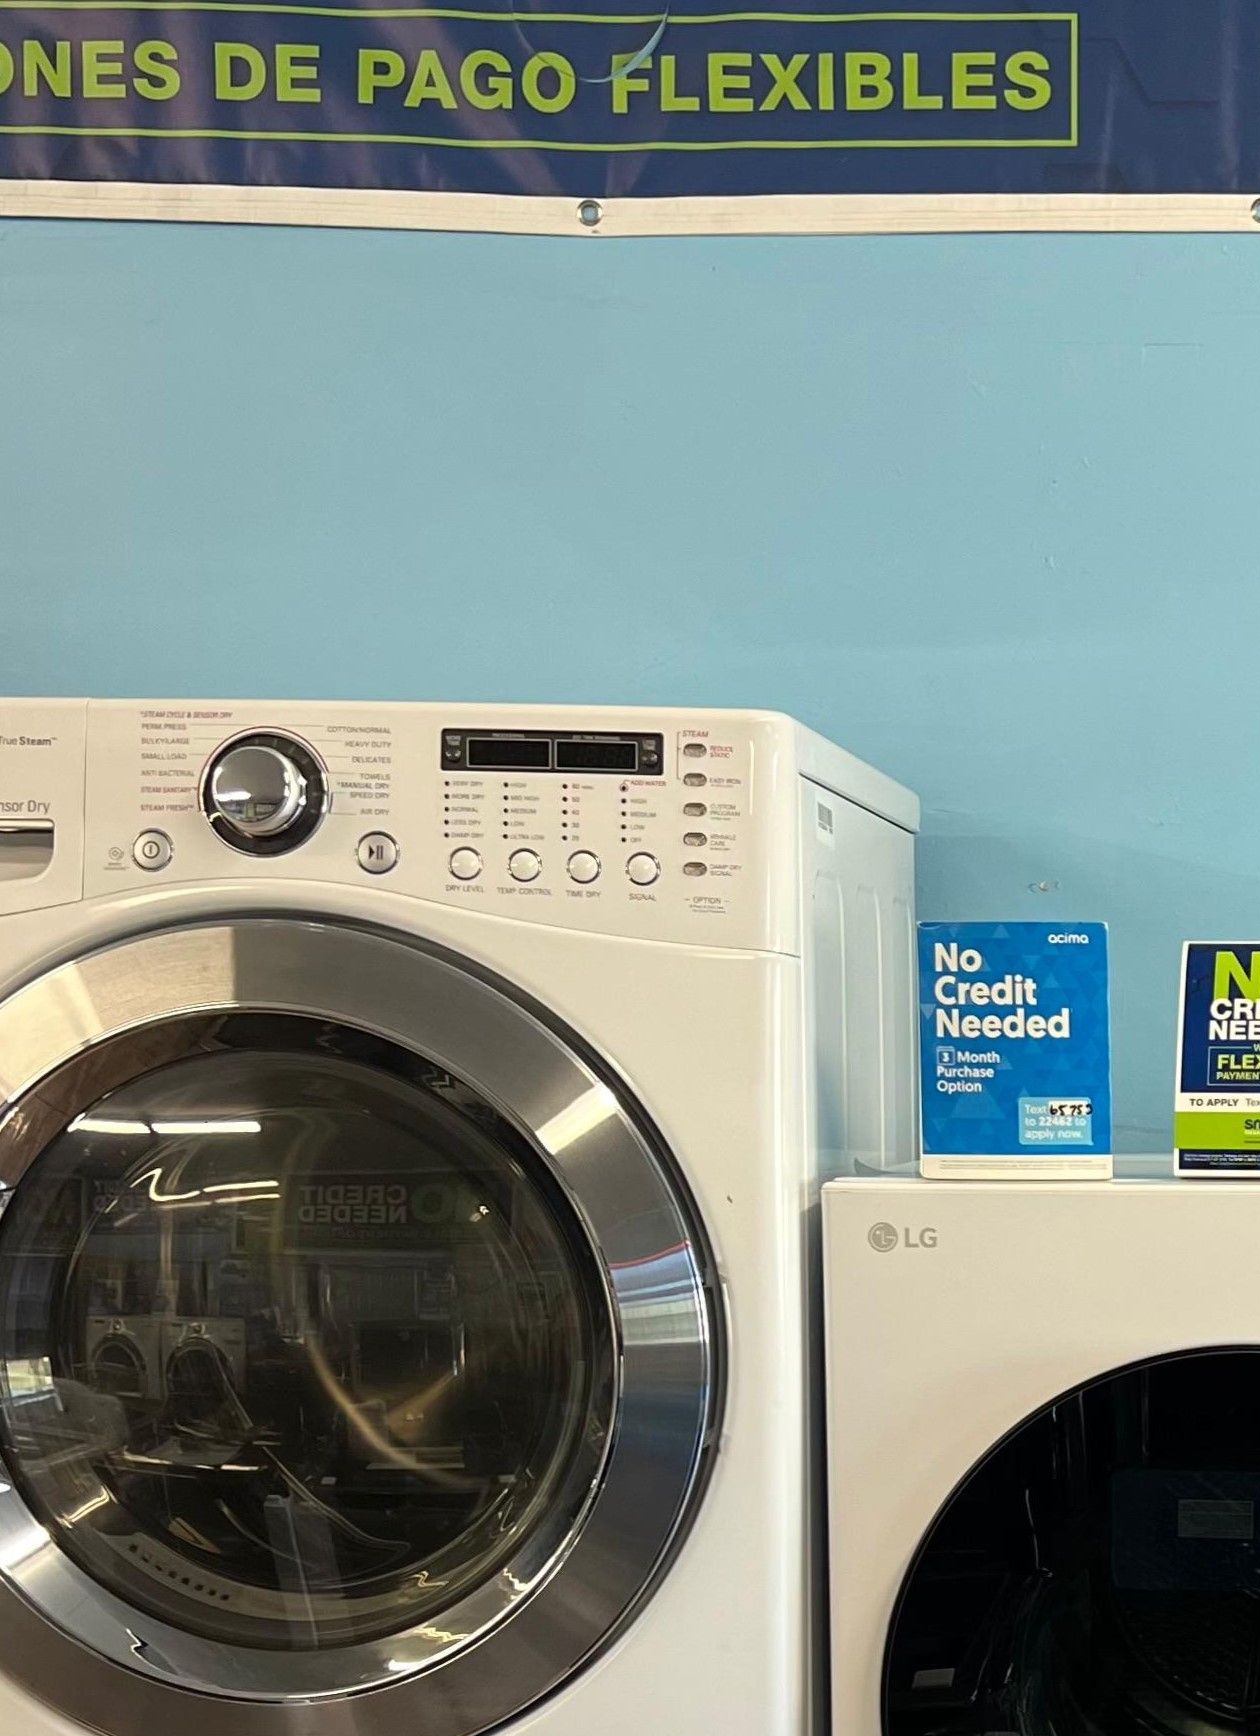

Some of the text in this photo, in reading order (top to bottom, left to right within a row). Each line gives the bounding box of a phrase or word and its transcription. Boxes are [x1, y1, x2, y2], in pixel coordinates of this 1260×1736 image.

[0, 40, 1052, 114] NES DE PAGO FLEXIBLES
[682, 730, 709, 738] STEAM
[27, 800, 51, 815] Dry
[446, 884, 461, 892] DRY
[693, 896, 721, 904] OPTION
[1048, 933, 1089, 945] acima
[934, 942, 982, 972] No
[934, 974, 1037, 1006] Credit
[936, 1008, 1071, 1038] Needed
[957, 1051, 1000, 1063] Month
[936, 1066, 994, 1078] Purchase
[936, 1080, 982, 1095] Option
[1190, 1098, 1205, 1106] TO
[1207, 1098, 1239, 1107] APPLY
[1025, 1117, 1037, 1126] to
[1074, 1116, 1087, 1126] to
[1024, 1129, 1055, 1140] apply
[903, 1226, 938, 1249] LG
